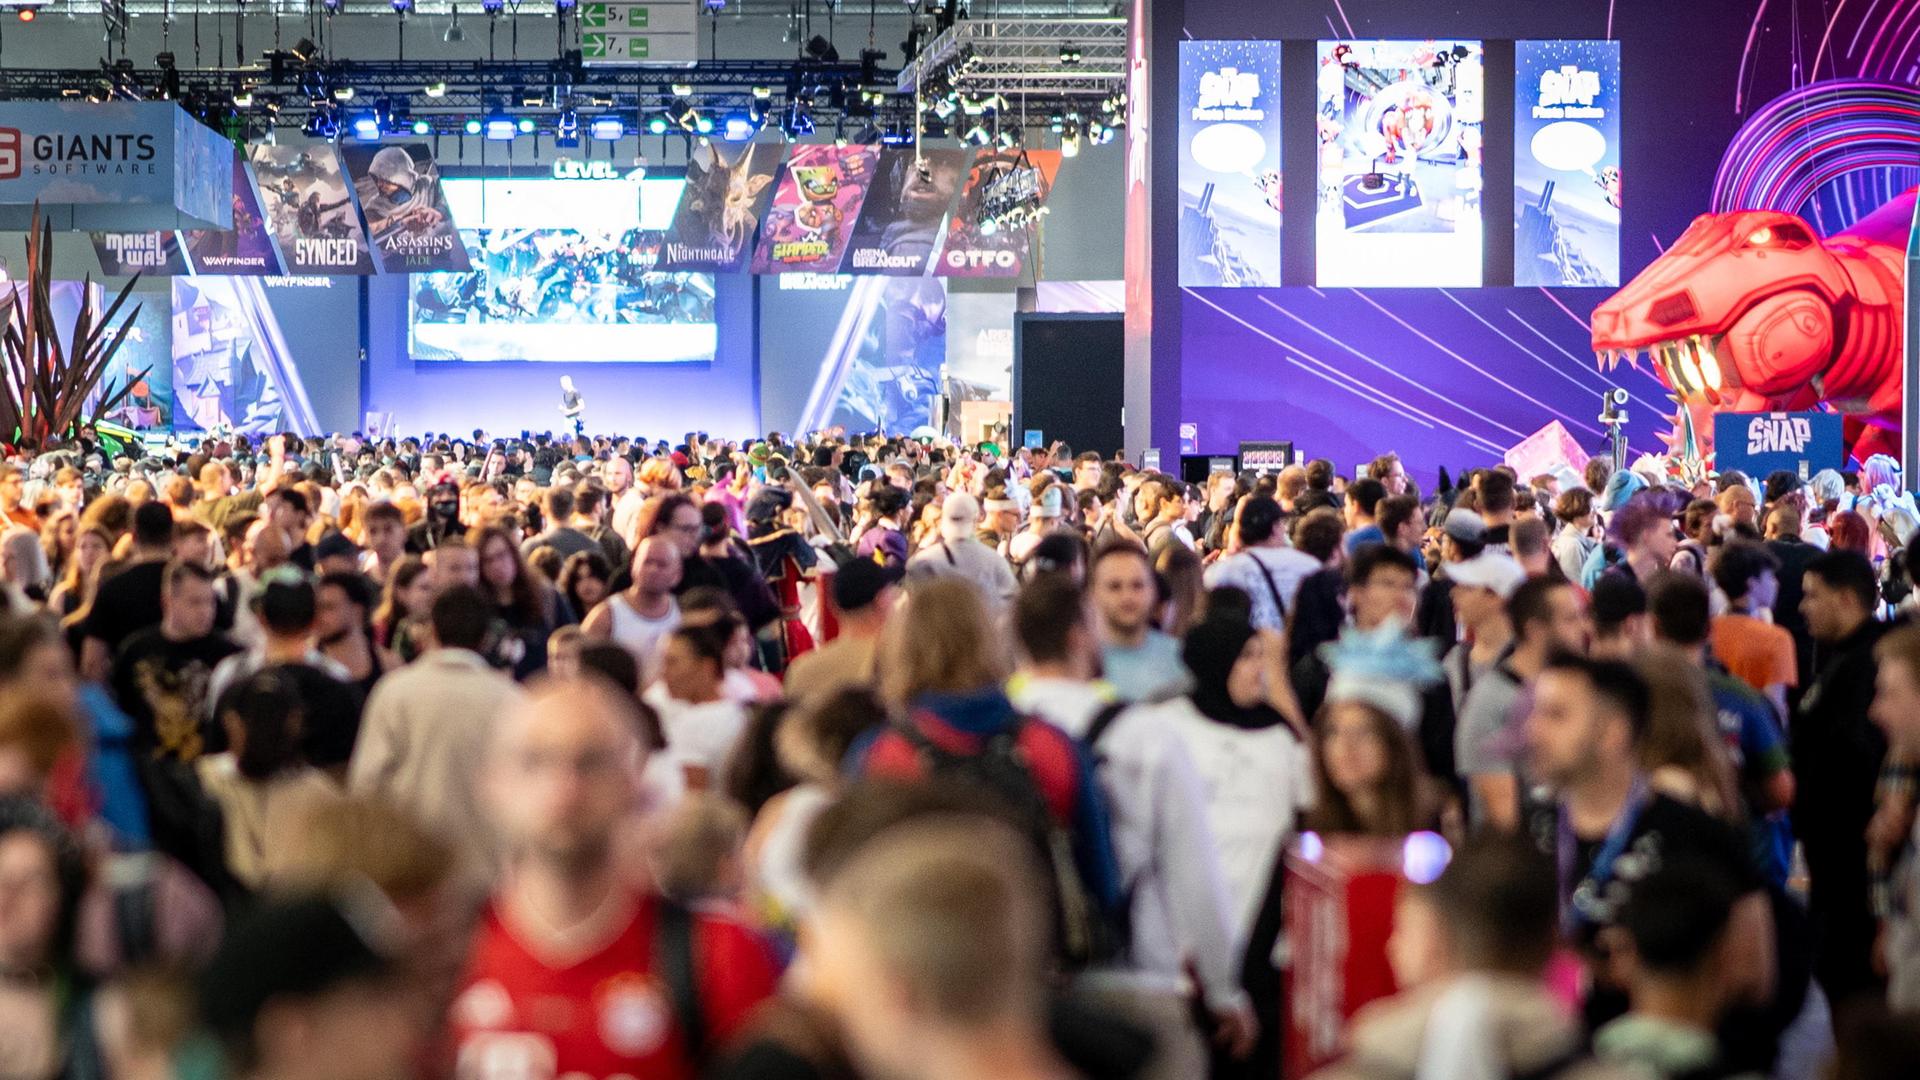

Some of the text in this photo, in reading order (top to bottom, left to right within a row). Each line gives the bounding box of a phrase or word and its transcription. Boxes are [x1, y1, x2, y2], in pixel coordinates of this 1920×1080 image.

[33, 135, 156, 161] GIANTS
[33, 163, 156, 175] SOFTWARE
[553, 160, 619, 179] LEVEL
[106, 233, 155, 264] MAKE
[126, 231, 167, 267] WAY
[295, 238, 358, 266] SYNCED
[853, 249, 888, 257] ARENA
[202, 256, 266, 268] WAYFINDER
[853, 256, 921, 268] BREAKOUT
[947, 250, 1016, 268] GTFO
[264, 275, 331, 289] WAYFINDER
[1747, 417, 1812, 456] SNAP
